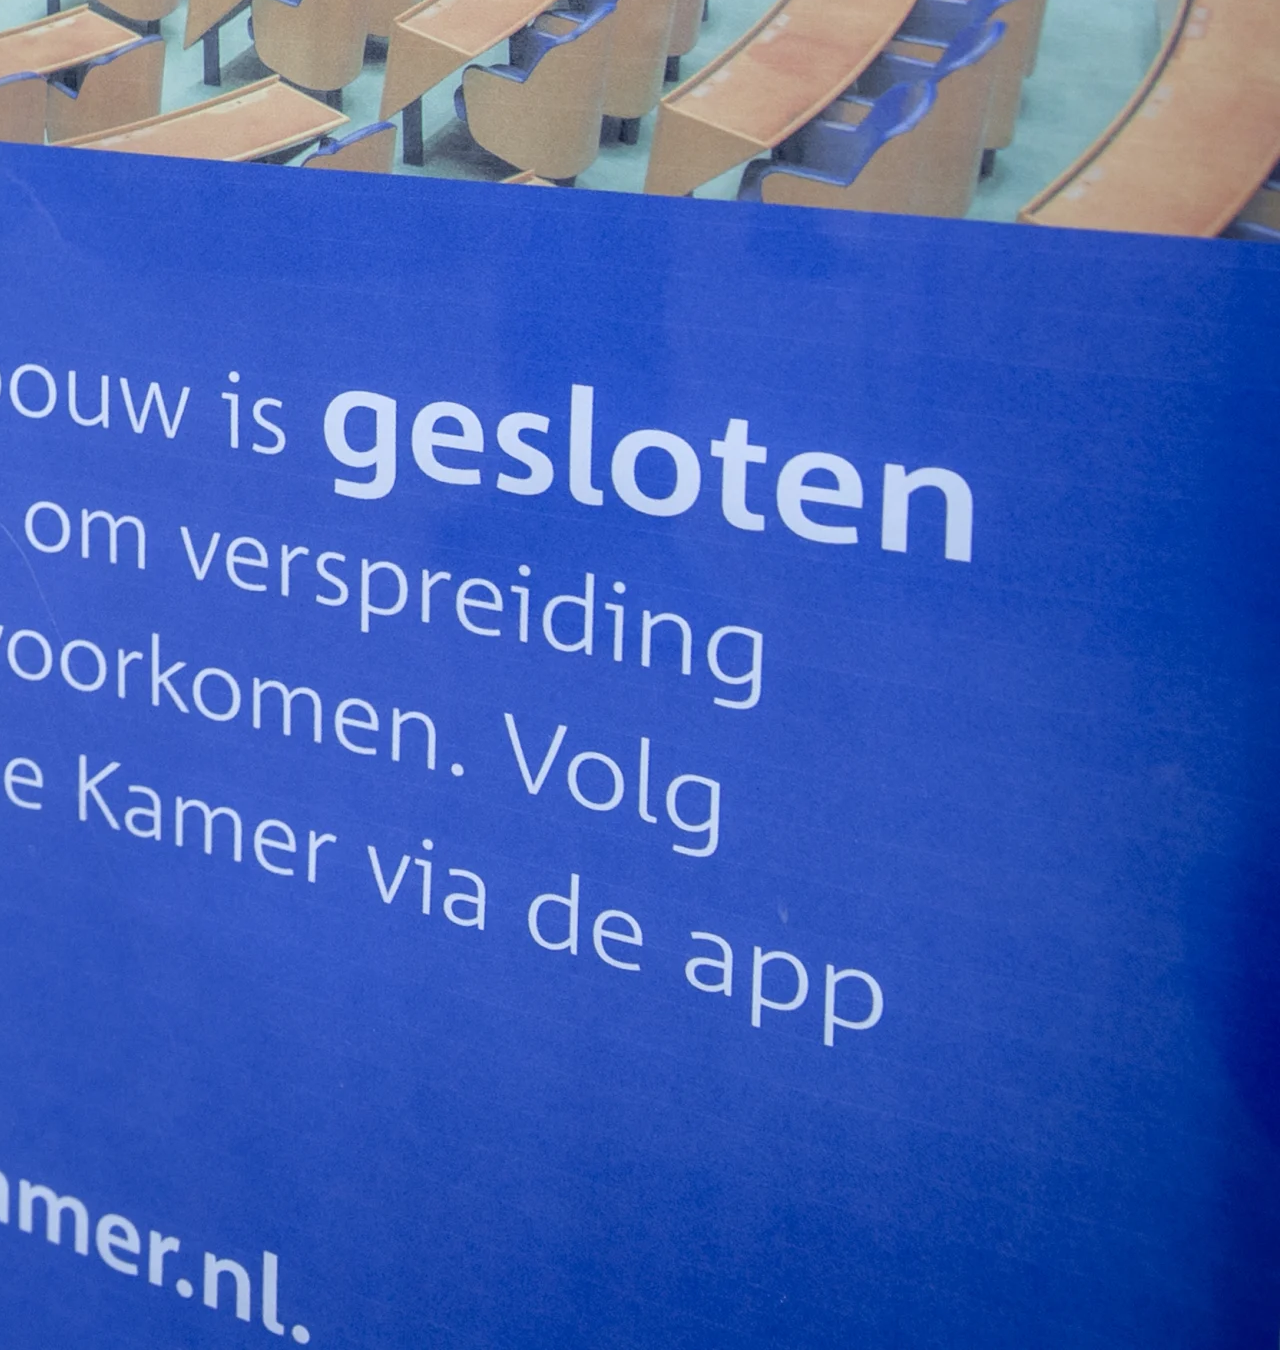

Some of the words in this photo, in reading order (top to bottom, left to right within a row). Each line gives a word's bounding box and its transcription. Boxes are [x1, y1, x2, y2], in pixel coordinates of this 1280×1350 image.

[221, 370, 287, 455] is
[323, 383, 974, 563] gesloten
[24, 500, 146, 570] om
[180, 525, 764, 710] verspreiding
[503, 712, 721, 858] Volg
[77, 754, 337, 883] Kamer
[367, 838, 487, 931] via
[527, 872, 644, 972] de
[684, 930, 884, 1047] app
